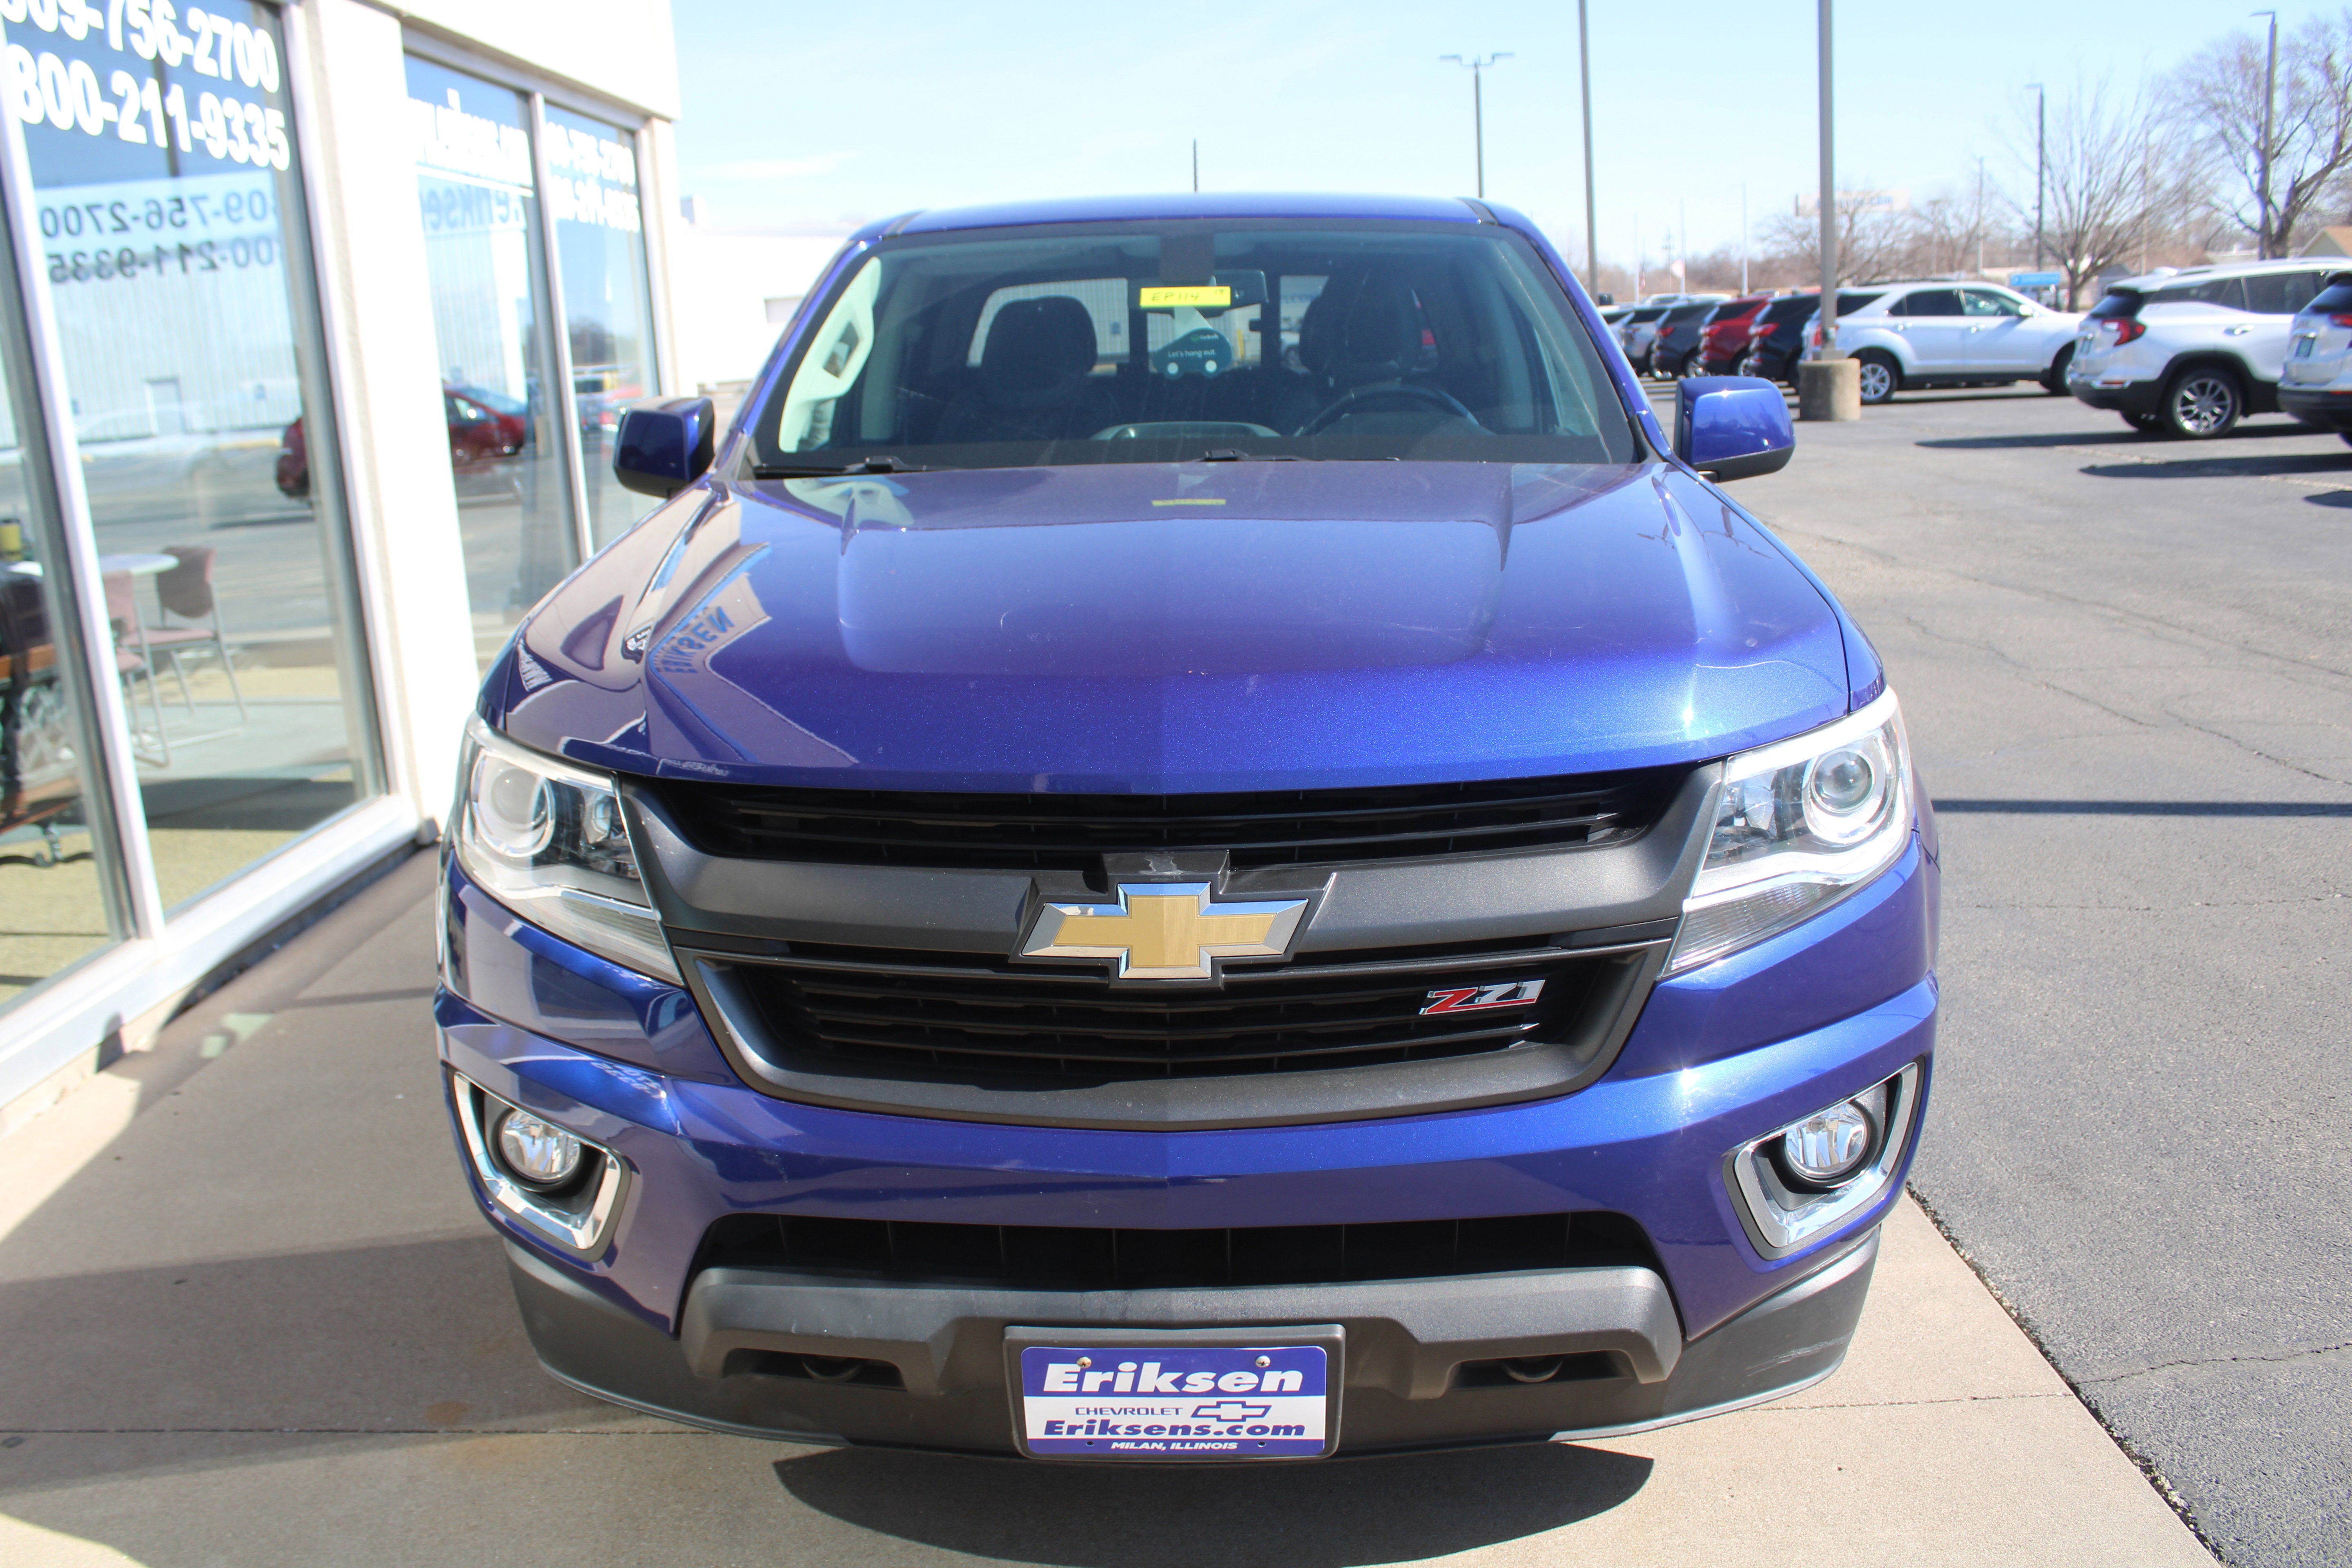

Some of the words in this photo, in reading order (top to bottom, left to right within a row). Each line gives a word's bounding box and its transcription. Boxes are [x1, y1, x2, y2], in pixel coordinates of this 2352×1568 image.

[6, 43, 290, 171] 800-211-9335
[1185, 350, 1202, 358] hang
[1419, 979, 1545, 1015] Z71
[1043, 1361, 1303, 1393] Eriksen
[1075, 1407, 1183, 1416] CHEVROLET
[1043, 1419, 1305, 1437] Eriksens.com
[1111, 1441, 1167, 1451] MILAN,
[1169, 1441, 1238, 1450] ILLINOIS
